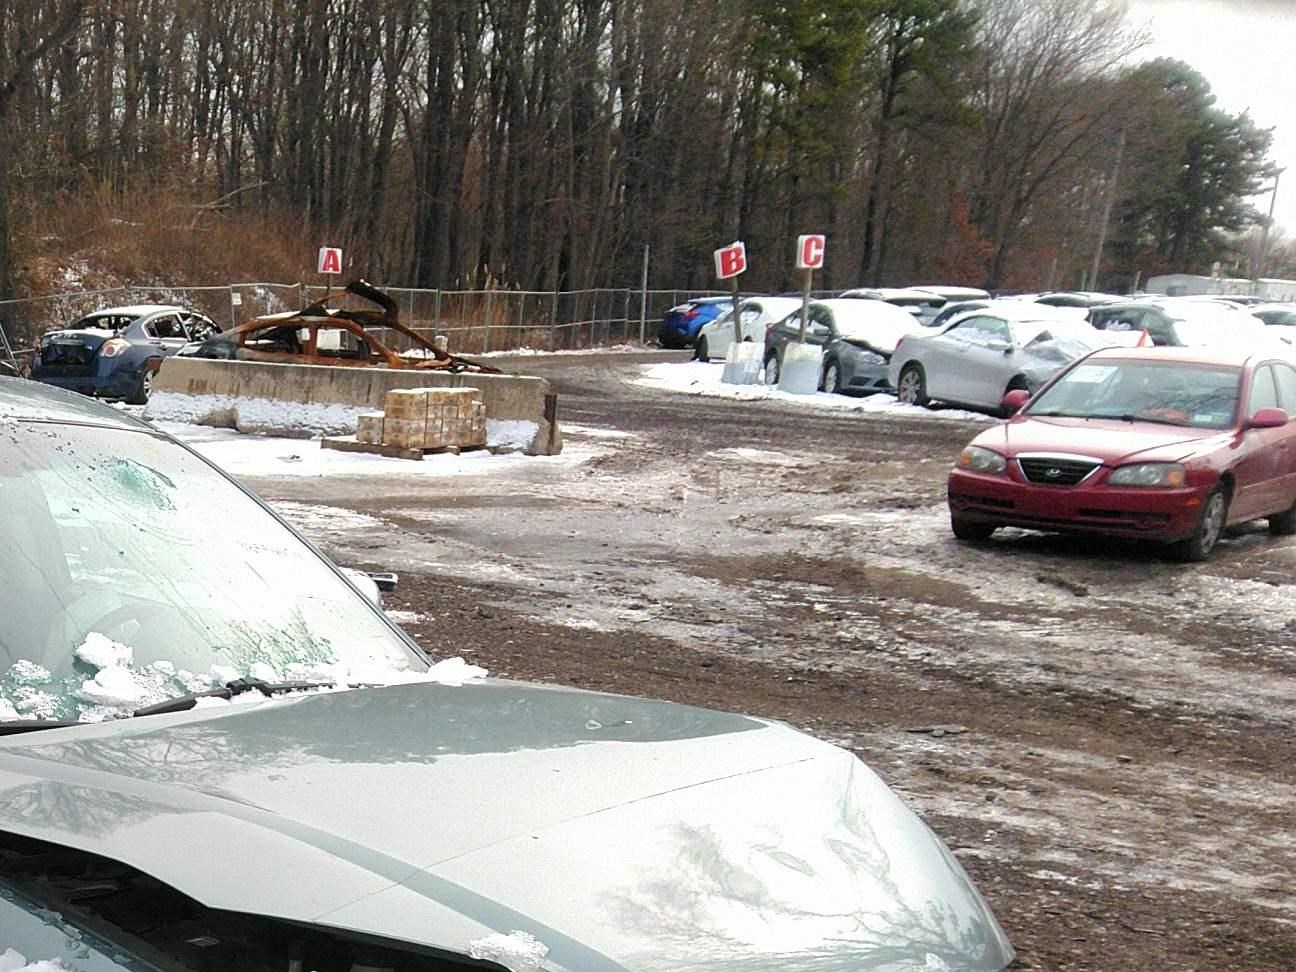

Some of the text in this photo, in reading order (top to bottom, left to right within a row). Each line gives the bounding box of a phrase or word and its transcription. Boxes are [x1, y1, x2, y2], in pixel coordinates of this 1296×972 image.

[323, 250, 340, 272] A
[720, 246, 745, 277] B
[804, 236, 823, 267] C
